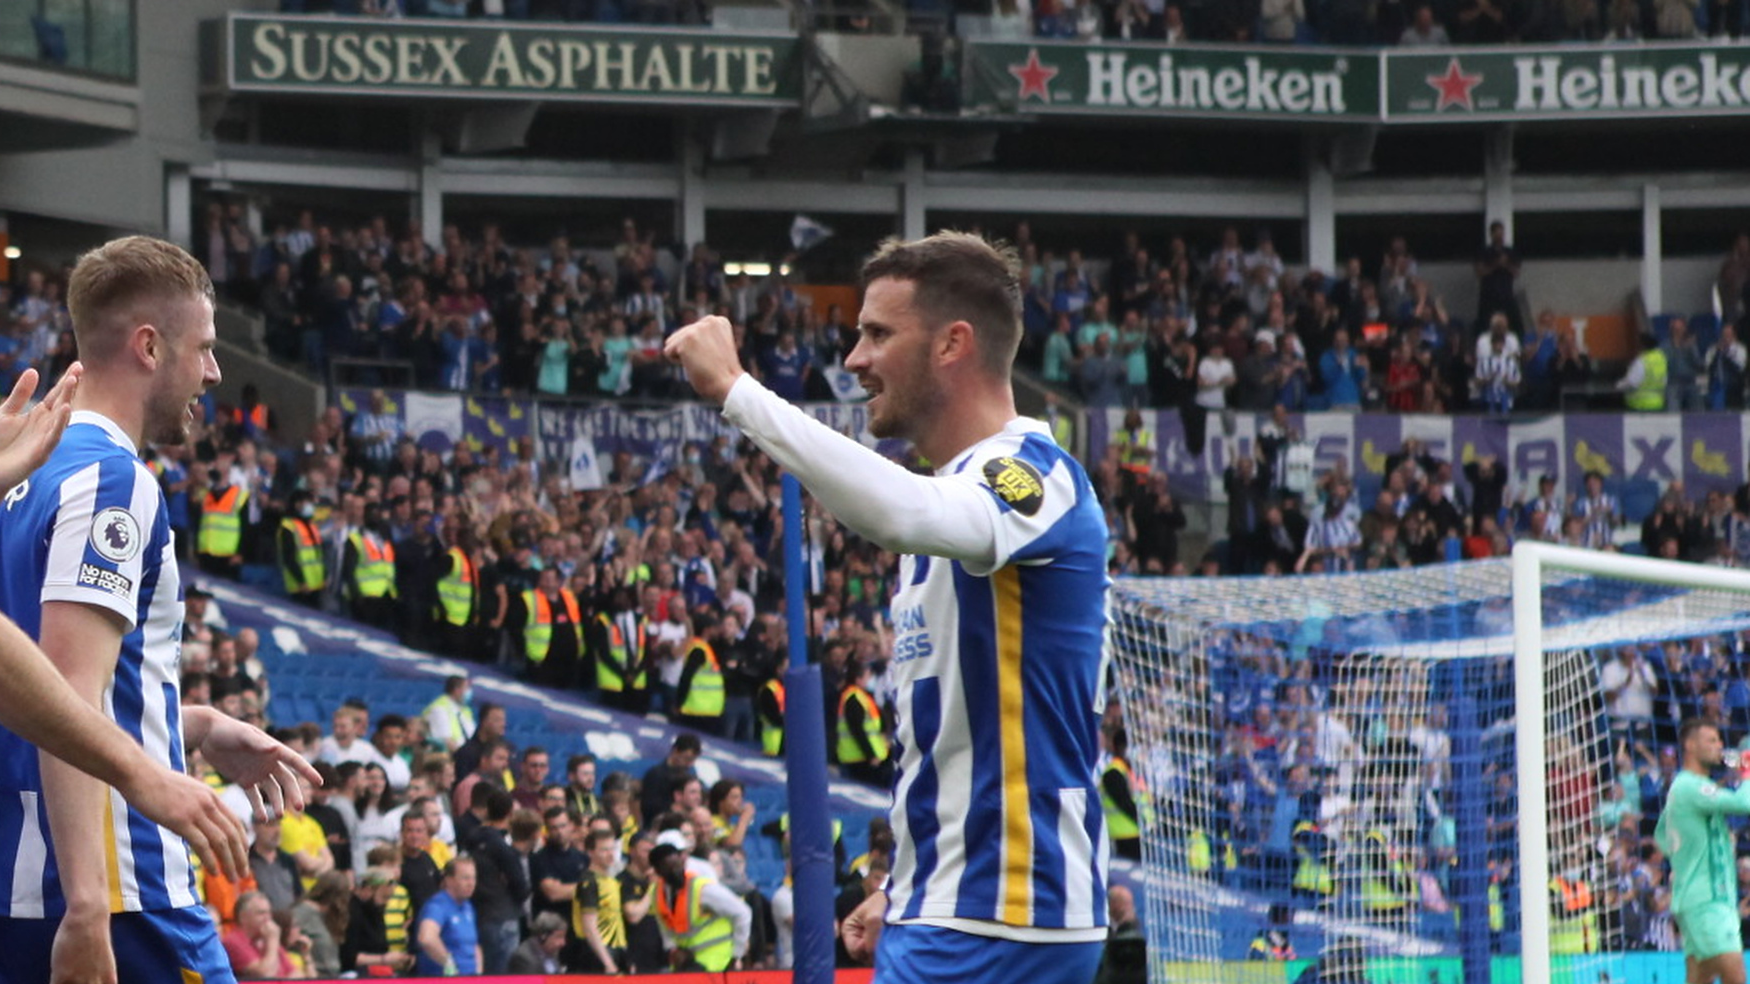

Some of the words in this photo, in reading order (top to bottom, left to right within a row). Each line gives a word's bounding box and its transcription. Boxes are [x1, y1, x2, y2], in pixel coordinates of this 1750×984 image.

[250, 23, 472, 87] SUSSEX
[481, 31, 777, 95] ASPHALTE
[1086, 51, 1345, 114] Heineken
[82, 563, 100, 577] No
